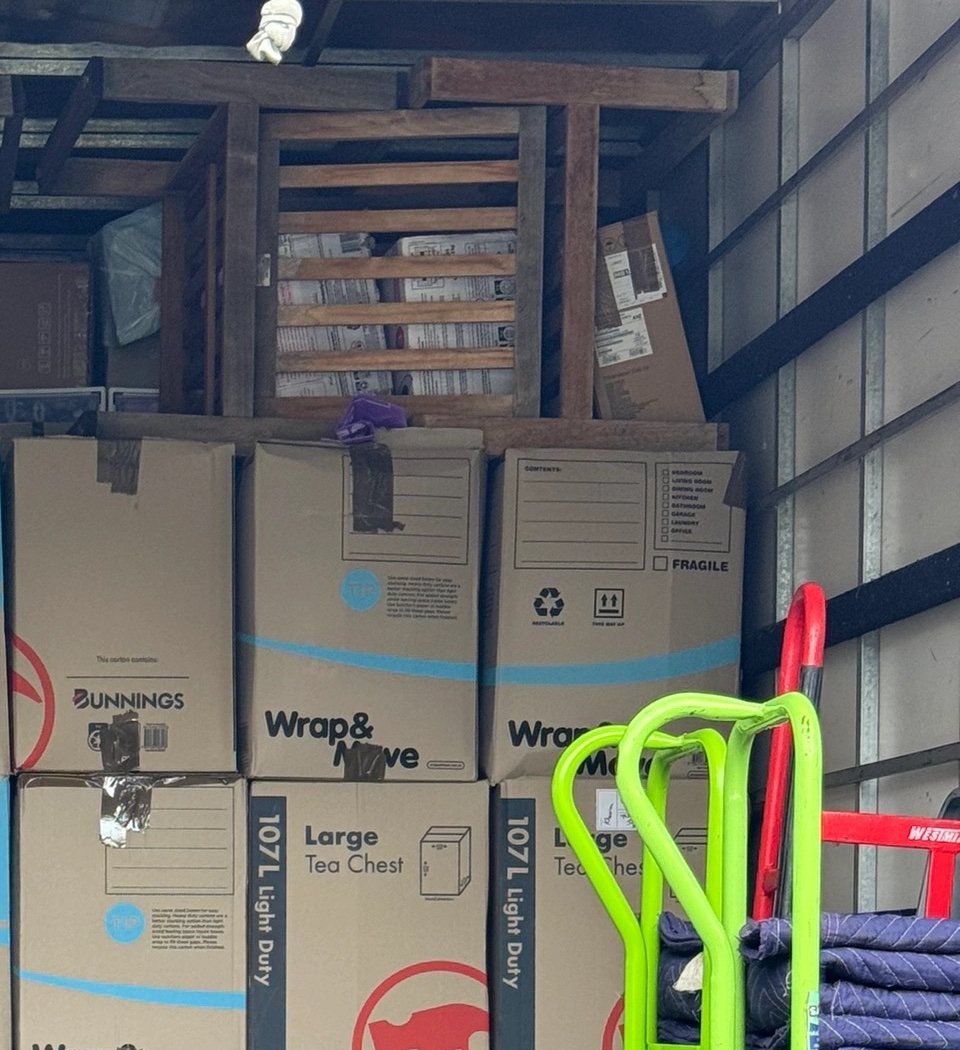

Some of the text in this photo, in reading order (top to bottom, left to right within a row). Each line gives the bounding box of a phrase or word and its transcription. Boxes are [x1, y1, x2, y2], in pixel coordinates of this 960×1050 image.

[672, 559, 729, 572] FRAGILE
[72, 688, 184, 710] BUNNINGS
[265, 710, 374, 746] Wrap&
[508, 720, 618, 748] Wra
[305, 825, 379, 851] Large
[554, 827, 628, 853] Lge
[305, 854, 340, 873] Tea
[347, 853, 404, 873] Chest
[254, 814, 281, 987] 107L Light Duty
[502, 816, 529, 989] 107L Light Duty
